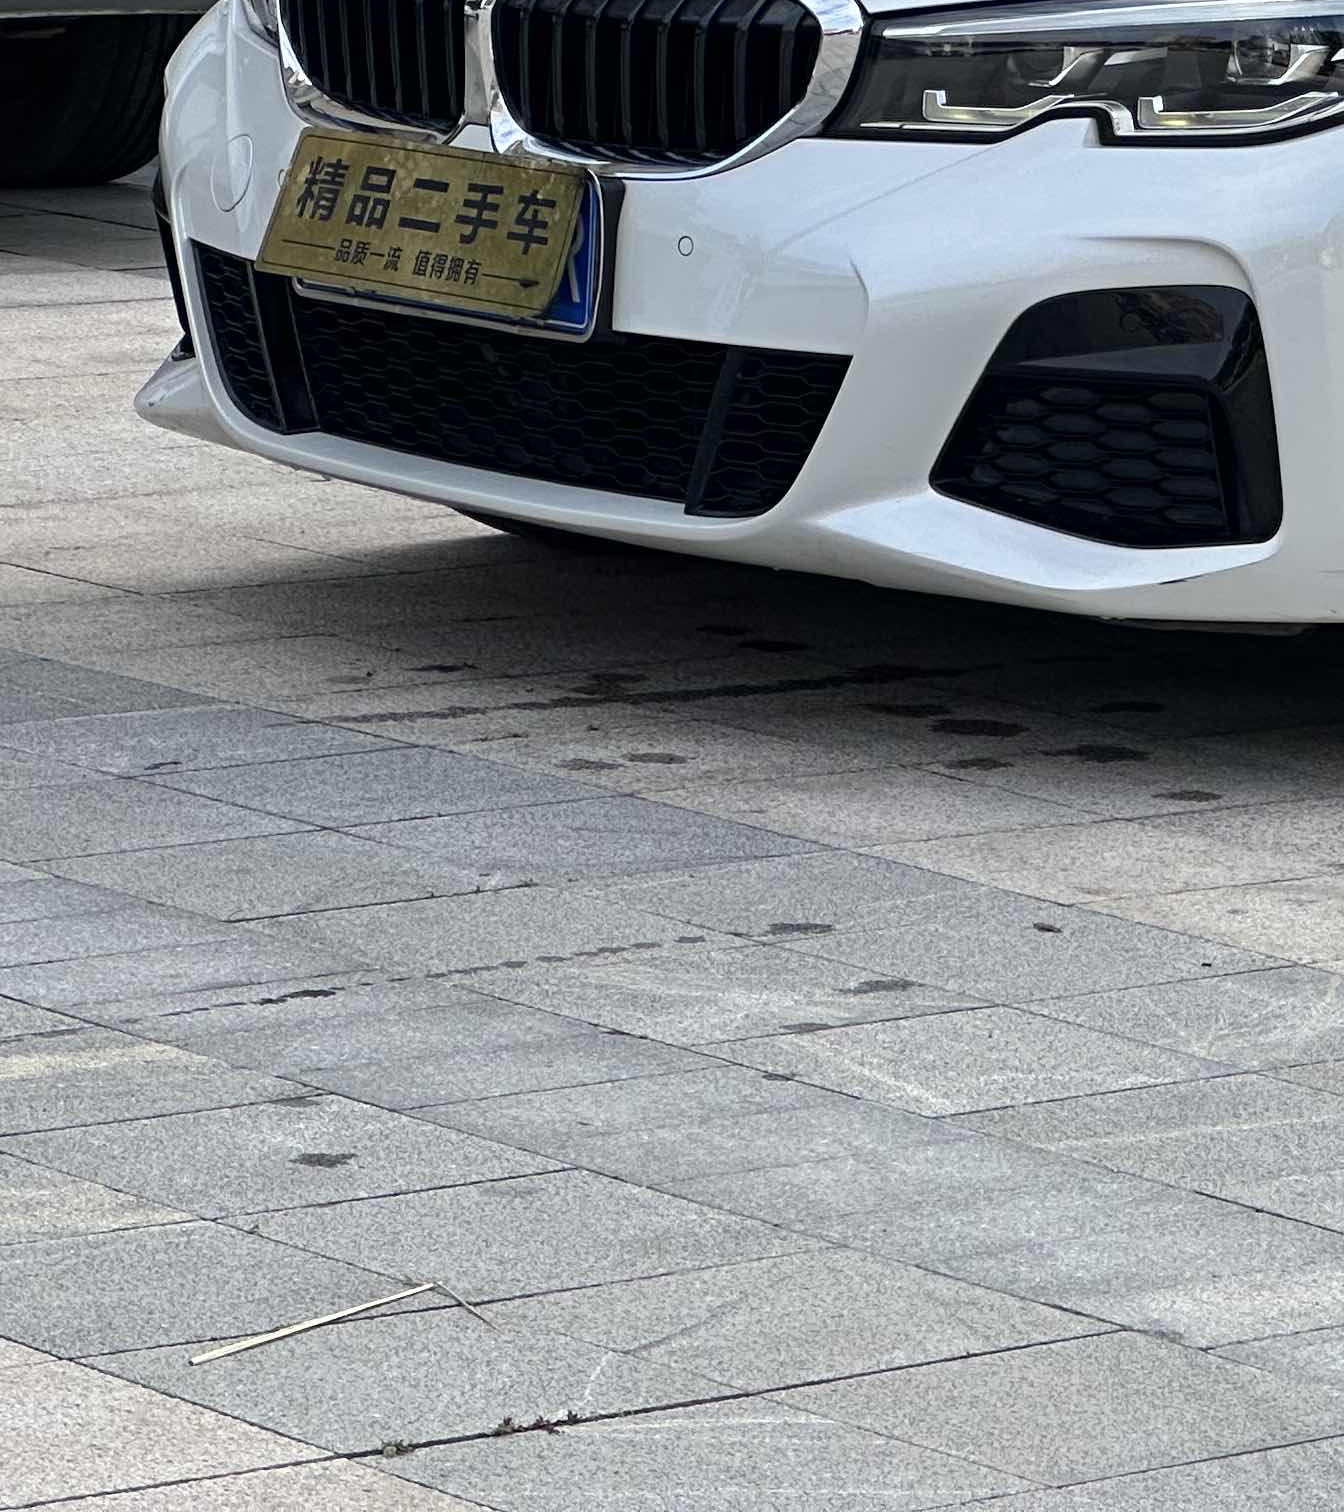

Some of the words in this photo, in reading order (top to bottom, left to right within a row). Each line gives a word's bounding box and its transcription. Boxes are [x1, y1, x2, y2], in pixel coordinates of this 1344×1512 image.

[296, 156, 557, 255] 精品二手车
[334, 238, 404, 272] 品质一流
[413, 249, 482, 285] 值得拥有
